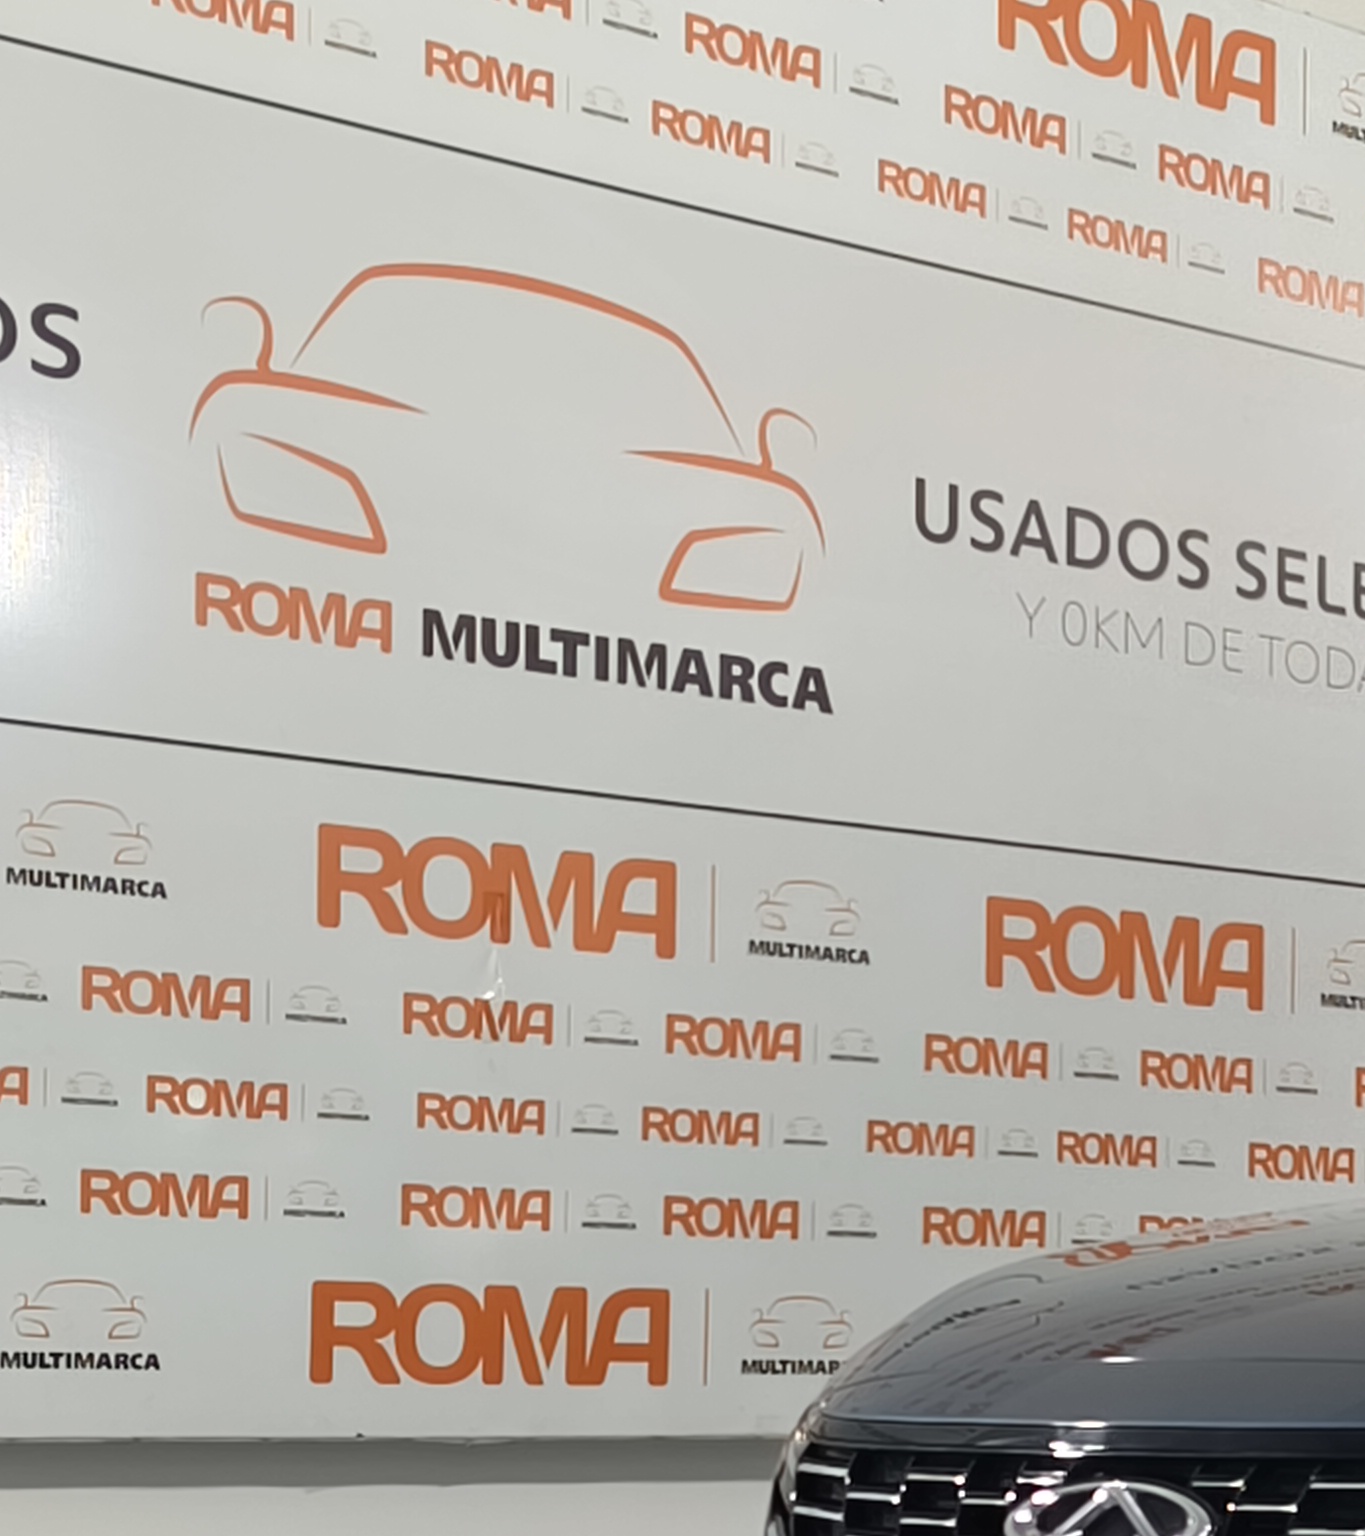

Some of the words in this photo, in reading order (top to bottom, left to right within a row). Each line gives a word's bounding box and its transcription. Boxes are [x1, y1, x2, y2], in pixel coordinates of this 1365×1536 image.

[425, 40, 554, 108] ROMA
[684, 13, 821, 89] ROMA
[652, 100, 770, 164] ROMA
[945, 84, 1066, 155] ROMA
[878, 159, 986, 218] ROMA
[1159, 144, 1270, 210] ROMA
[1068, 208, 1167, 263] ROMA
[1258, 258, 1364, 317] ROMA
[915, 476, 1211, 590] USADOS
[195, 572, 392, 654] ROMA
[421, 608, 831, 714] MULTIMARCA
[1016, 592, 1047, 638] Y
[1184, 621, 1244, 674] DE
[6, 866, 168, 899] MULTIMARCA
[317, 823, 677, 960] ROMA
[748, 938, 871, 965] MULTIMARCA
[985, 896, 1264, 1011] ROMA
[81, 965, 250, 1022] ROMA
[402, 992, 553, 1045] ROMA
[665, 1013, 801, 1062] ROMA
[924, 1033, 1049, 1079] ROMA
[146, 1074, 288, 1121] ROMA
[1140, 1050, 1253, 1095] ROMA
[417, 1092, 545, 1135] ROMA
[641, 1106, 759, 1147] ROMA
[866, 1120, 975, 1158] ROMA
[1056, 1131, 1157, 1169] ROMA
[1248, 1143, 1355, 1184] ROMA
[80, 1168, 249, 1220] ROMA
[401, 1183, 551, 1231] ROMA
[663, 1195, 799, 1240] ROMA
[922, 1206, 1046, 1249] ROMA
[309, 1280, 671, 1387] ROMA
[0, 1351, 160, 1371] MULTIMARCA
